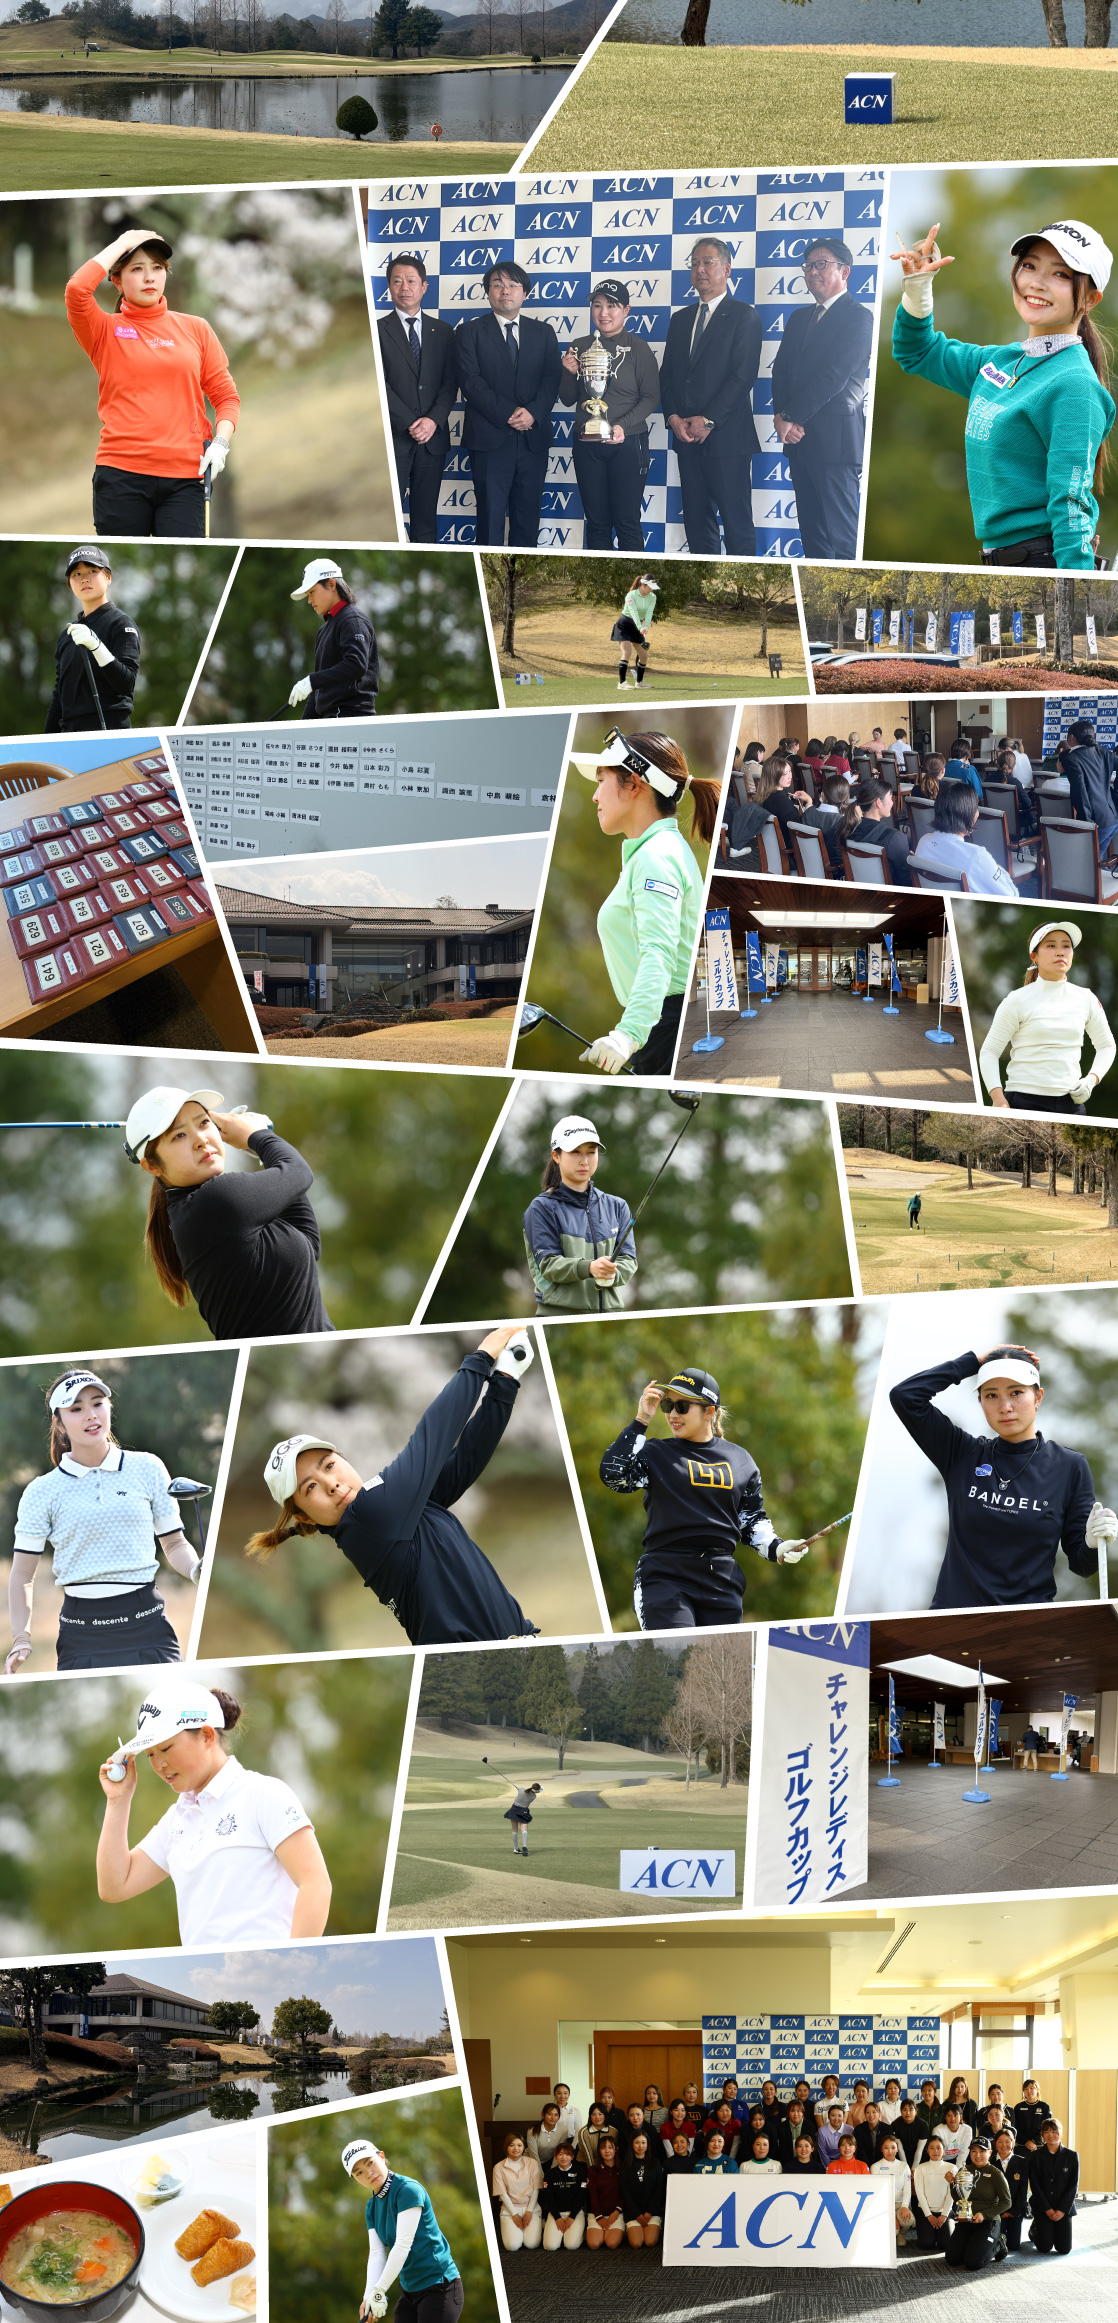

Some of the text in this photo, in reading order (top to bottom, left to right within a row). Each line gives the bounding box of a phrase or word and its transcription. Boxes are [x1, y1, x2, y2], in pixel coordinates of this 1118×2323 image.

[848, 94, 888, 108] ACN
[452, 182, 502, 199] ACN
[527, 180, 579, 196] ACN
[604, 178, 658, 193] ACN
[685, 175, 741, 190] ACN
[379, 184, 429, 202] ACN
[604, 208, 661, 228] ACN
[684, 204, 745, 226] ACN
[768, 200, 832, 222] ACN
[378, 216, 430, 236] ACN
[451, 213, 504, 233] ACN
[526, 211, 582, 231] ACN
[378, 249, 429, 269] AN
[450, 248, 503, 267] ACN
[526, 246, 580, 265] ACN
[603, 244, 660, 264] ACN
[450, 282, 488, 300] AC
[526, 281, 580, 300] ACN
[624, 279, 659, 298] CN
[767, 276, 810, 295] AC
[533, 316, 578, 334] CN
[623, 315, 659, 334] CN
[442, 489, 477, 507] AC
[540, 492, 574, 510] CN
[764, 500, 799, 519] AC
[439, 525, 476, 543] AC
[537, 527, 572, 546] CN
[764, 538, 802, 558] AC
[62, 871, 75, 884] 613
[151, 868, 167, 882] 617
[18, 889, 30, 904] 552
[116, 884, 130, 898] 653
[76, 901, 88, 917] 643
[172, 901, 187, 916] 655
[132, 920, 148, 936] 507
[709, 915, 728, 927] ACN
[27, 921, 40, 939] 629
[90, 939, 104, 957] 621
[42, 961, 55, 982] 641
[749, 944, 765, 984] ACN
[768, 951, 776, 980] ACN
[872, 950, 880, 979] ACN
[714, 956, 724, 1008] ゴルフカップ
[65, 1377, 97, 1393] SRIXON
[136, 1603, 164, 1619] descente
[92, 1616, 129, 1626] descente
[176, 1718, 207, 1726] APEX
[936, 1711, 944, 1742] ACN
[825, 1673, 848, 1891] チャレンジレディス
[784, 1743, 814, 1905] ゴルフカップ
[631, 1858, 725, 1889] ACN
[707, 2018, 732, 2027] ACN
[741, 2018, 766, 2027] ACN
[775, 2018, 800, 2028] ACN
[810, 2018, 834, 2028] ACN
[844, 2018, 869, 2028] ACN
[878, 2018, 903, 2028] ACN
[912, 2019, 937, 2028] ACN
[707, 2033, 732, 2042] ACN
[741, 2033, 766, 2042] ACN
[775, 2033, 800, 2042] ACN
[810, 2033, 834, 2042] ACN
[844, 2033, 869, 2042] ACN
[878, 2033, 903, 2043] ACN
[912, 2033, 937, 2043] ACN
[707, 2047, 732, 2057] ACN
[741, 2047, 766, 2057] ACN
[775, 2047, 800, 2057] ACN
[810, 2047, 834, 2057] ACN
[844, 2048, 869, 2057] ACN
[878, 2048, 903, 2057] ACN
[912, 2048, 937, 2057] ACN
[707, 2062, 732, 2071] ACN
[741, 2062, 766, 2071] ACN
[775, 2062, 800, 2071] ACN
[810, 2062, 834, 2071] ACN
[844, 2062, 869, 2072] ACN
[878, 2062, 903, 2072] ACN
[912, 2063, 937, 2072] ACN
[682, 2191, 875, 2248] ACN
